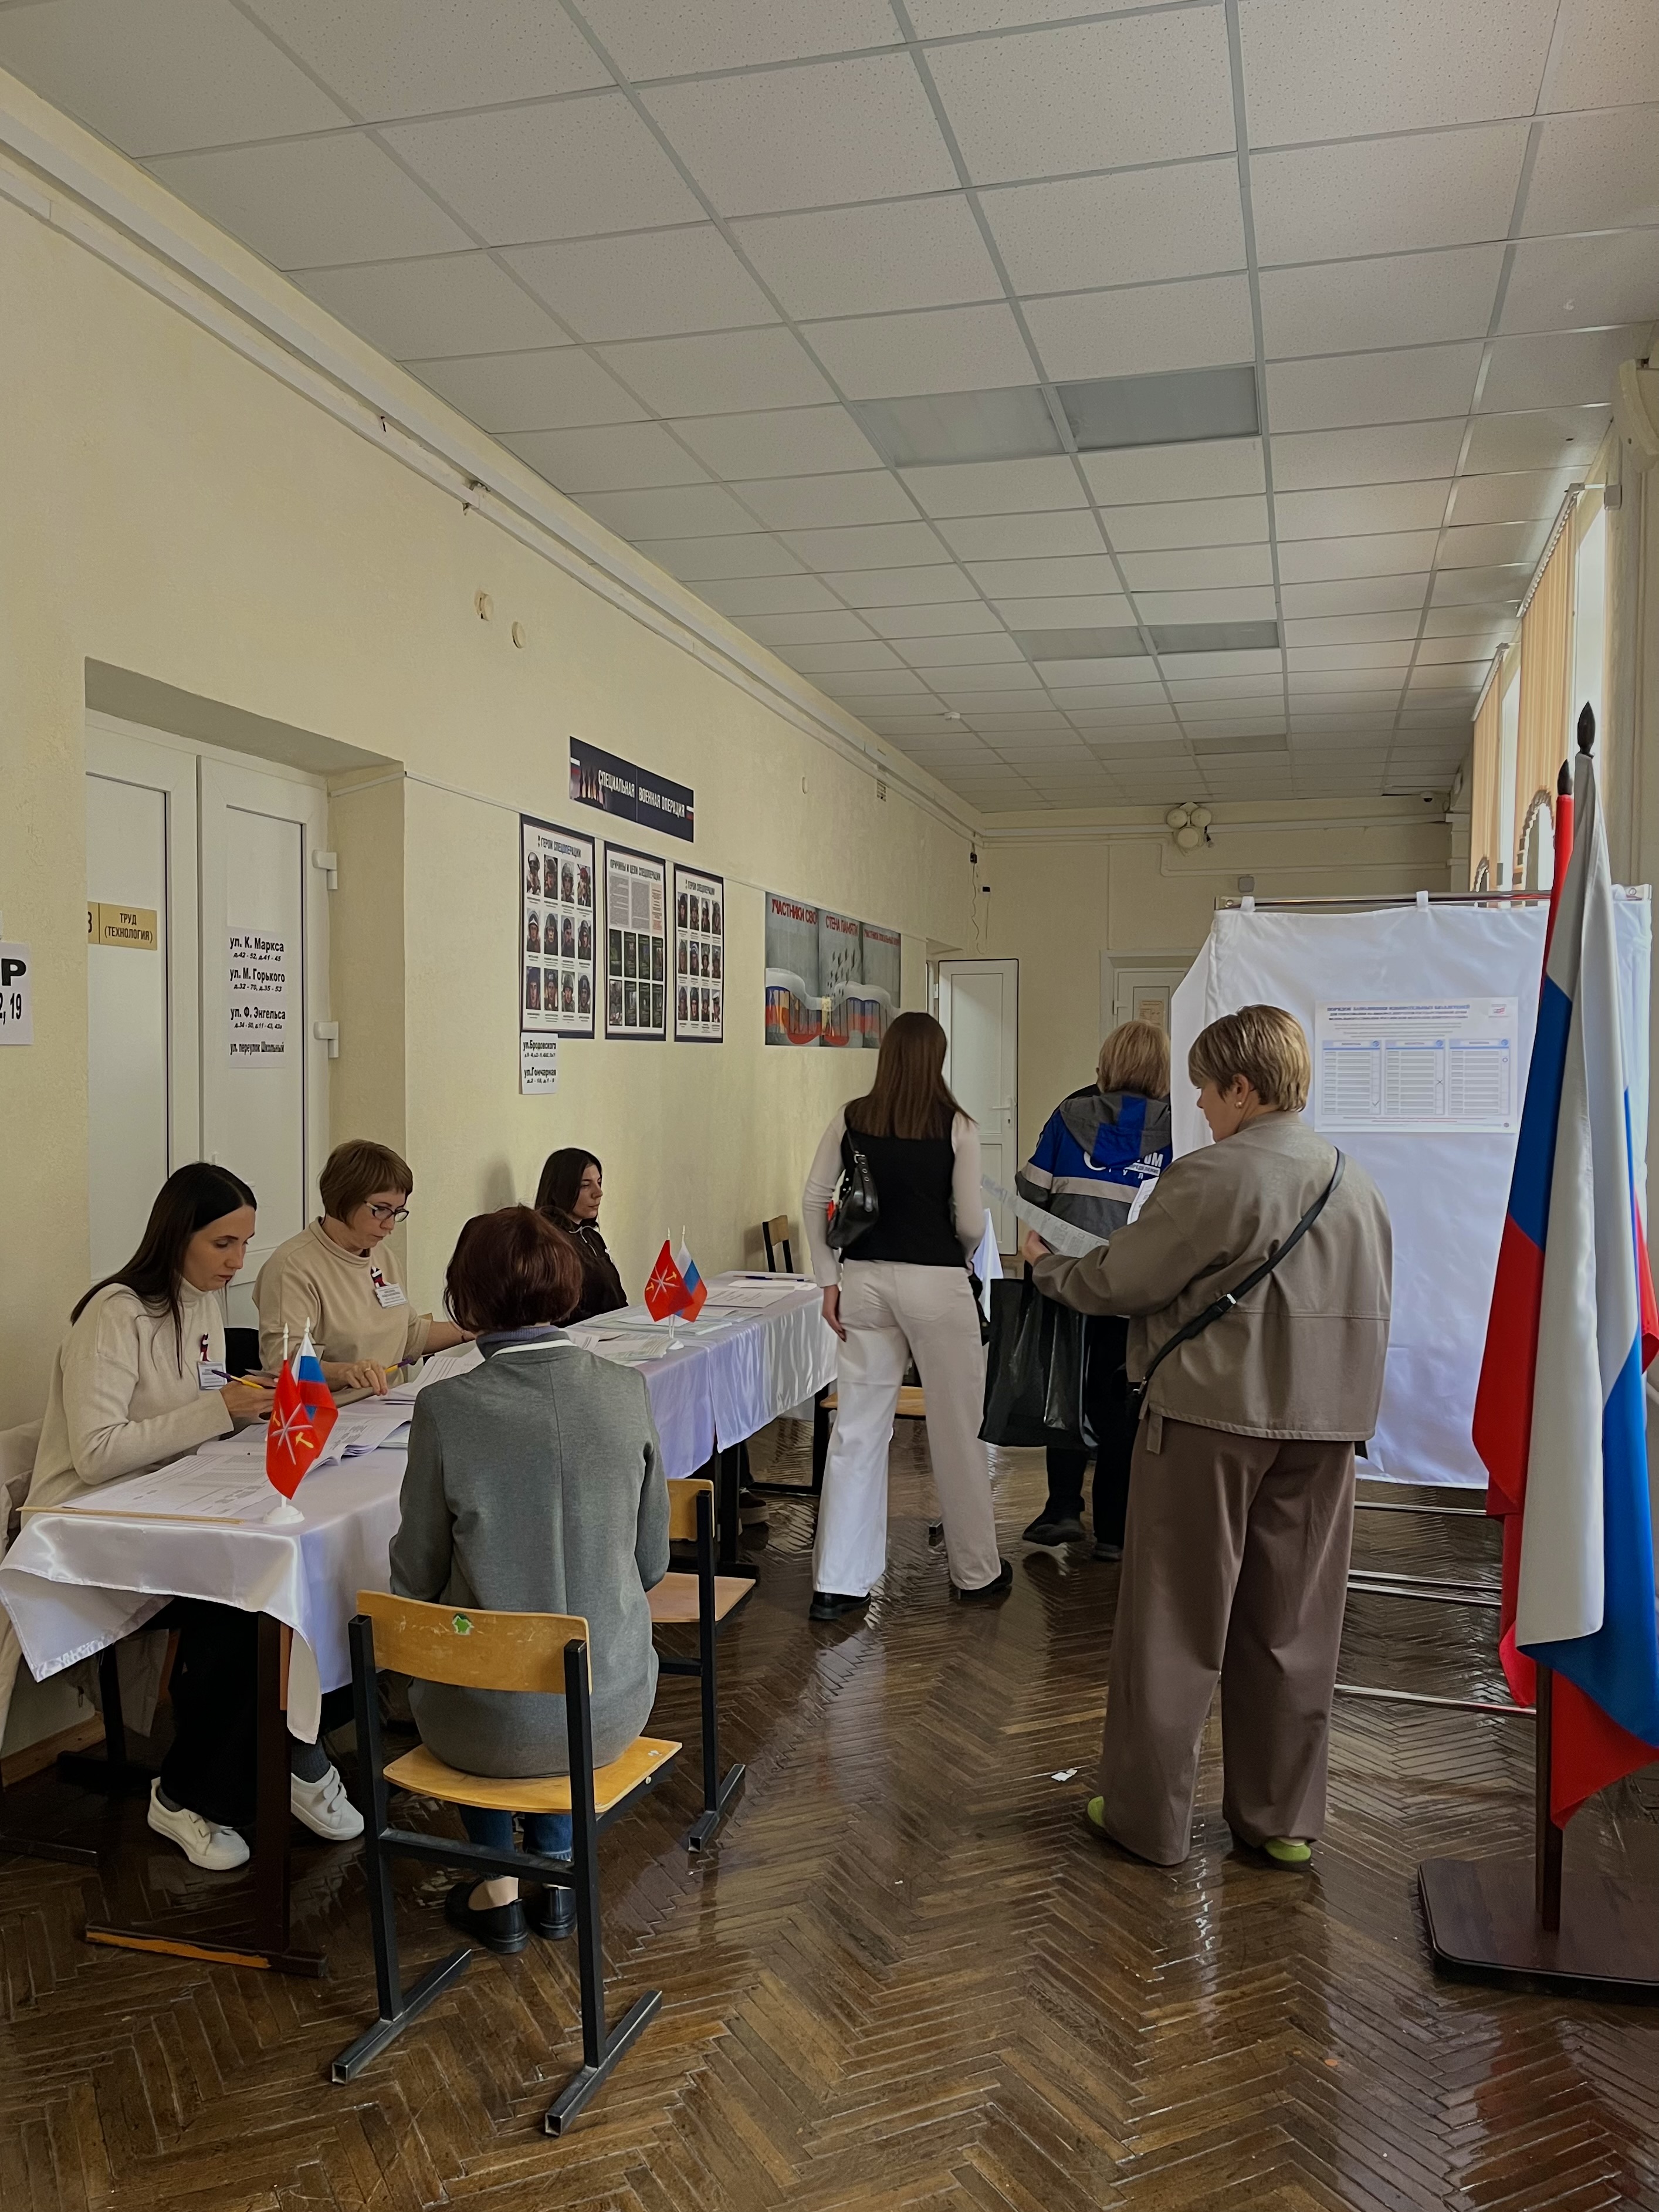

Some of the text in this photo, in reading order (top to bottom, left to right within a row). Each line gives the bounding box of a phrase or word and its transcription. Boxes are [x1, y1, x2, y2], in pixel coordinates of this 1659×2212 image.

[598, 770, 685, 818] СПЕЦИАЛЬНАЯ ВОЕННАЯ ОПЕРАЦИЯ
[120, 913, 137, 925] ТРУД
[771, 899, 817, 925] УЧАСТНИКИ СВО
[826, 915, 840, 931] СТЕНА
[104, 926, 153, 943] (ТЕХНОЛОГИЯ)
[230, 936, 284, 953] ул. К. Маркса
[1, 958, 26, 986] Р
[230, 968, 285, 983] ул. М. Горького
[10, 993, 22, 1020] 19
[231, 1006, 286, 1020] ул. Ф. Энгельса
